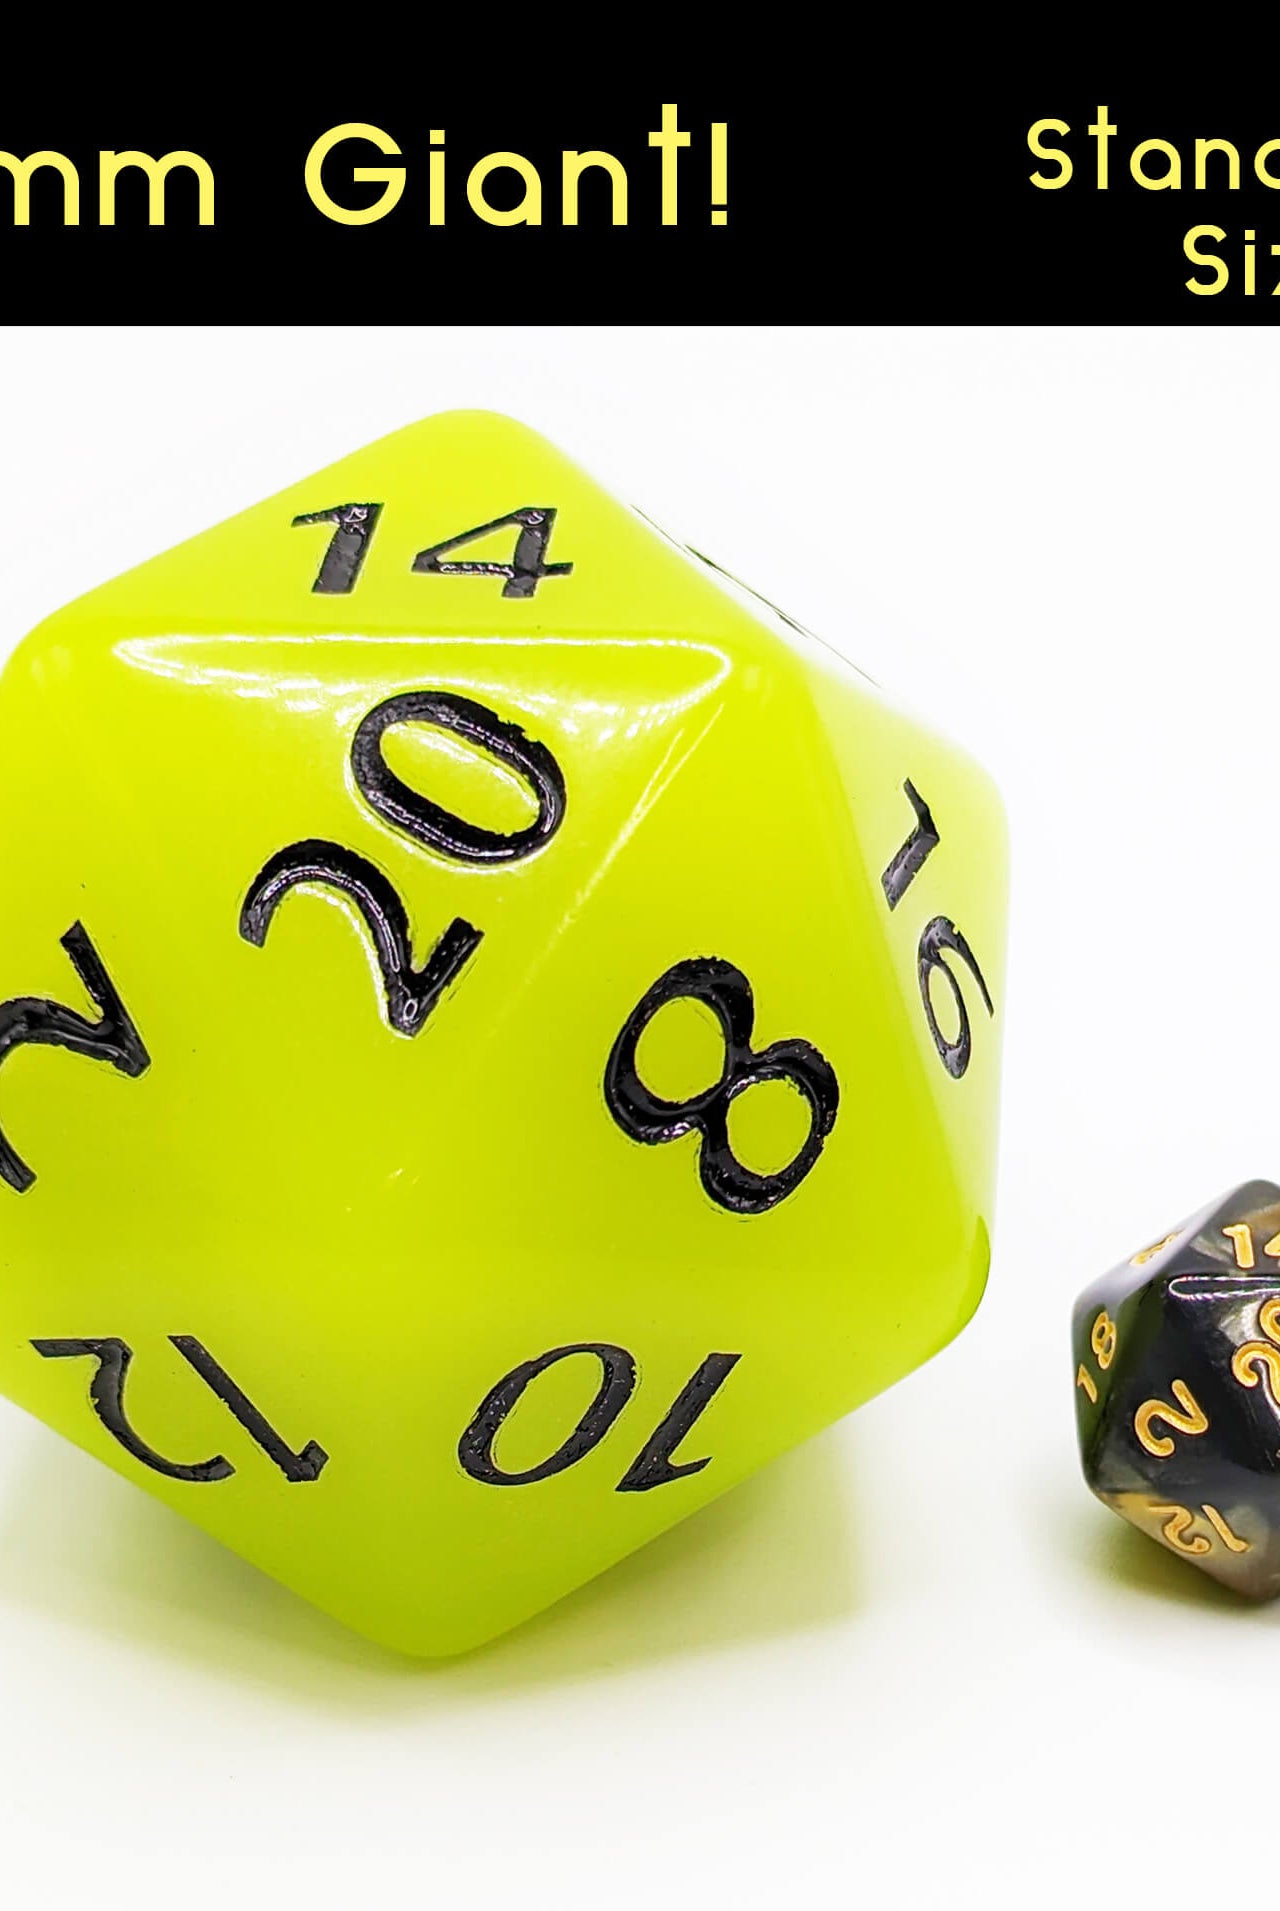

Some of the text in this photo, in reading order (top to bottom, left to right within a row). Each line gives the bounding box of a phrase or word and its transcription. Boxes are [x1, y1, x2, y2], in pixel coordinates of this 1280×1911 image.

[290, 502, 573, 598] 14
[239, 690, 567, 1037] 20
[881, 778, 995, 1080] 16
[604, 955, 840, 1216] 8
[29, 1335, 330, 1484] 12
[457, 1342, 743, 1493] 10
[1076, 1310, 1118, 1404] 18
[1134, 1378, 1210, 1458] 2
[1146, 1503, 1252, 1555] 12
